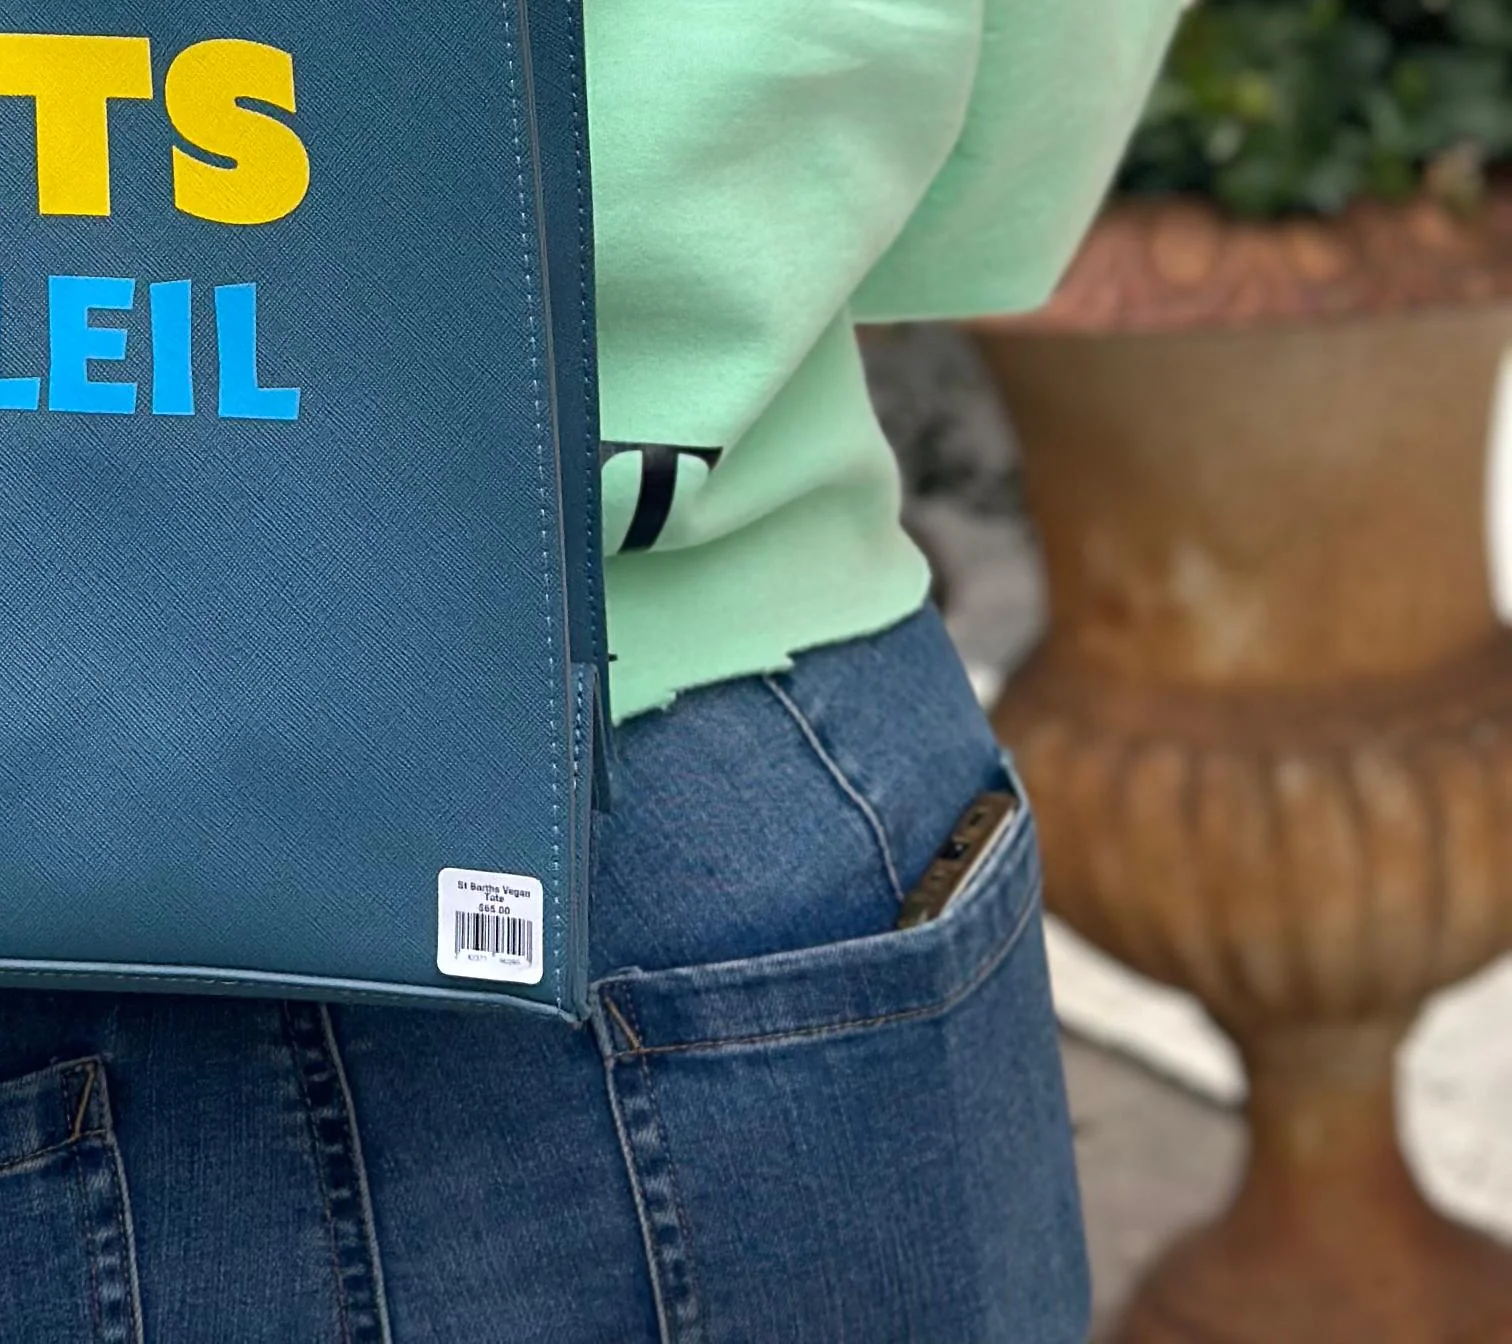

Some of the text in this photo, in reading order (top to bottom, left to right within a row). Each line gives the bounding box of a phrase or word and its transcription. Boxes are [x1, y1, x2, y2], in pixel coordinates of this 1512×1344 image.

[457, 880, 531, 898] St Barths Vegan
